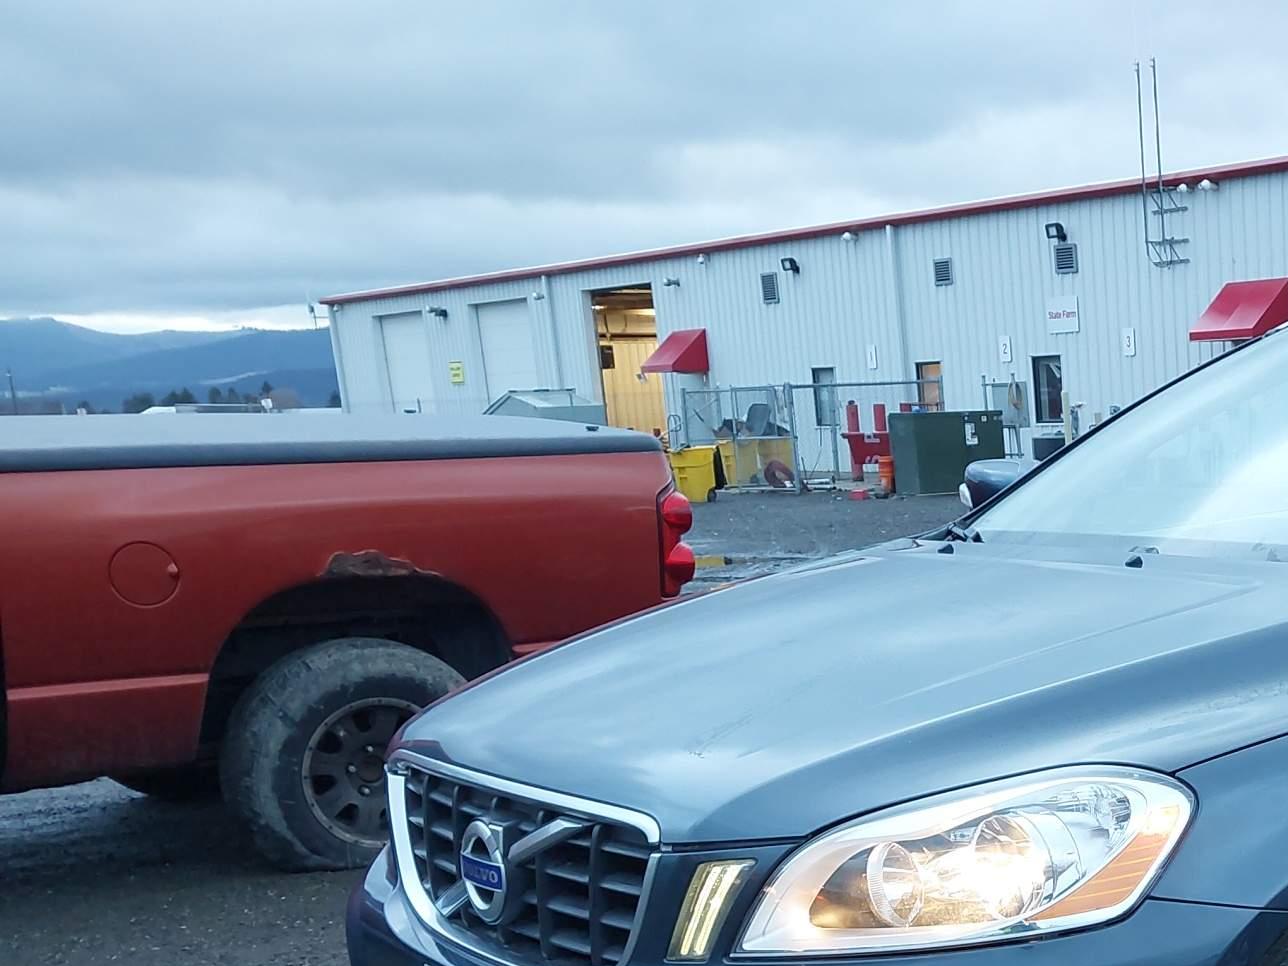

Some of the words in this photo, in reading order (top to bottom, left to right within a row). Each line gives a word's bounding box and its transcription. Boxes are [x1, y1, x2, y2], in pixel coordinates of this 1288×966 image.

[1126, 335, 1131, 348] 3
[1002, 343, 1008, 355] 2
[464, 859, 499, 884] LVO
